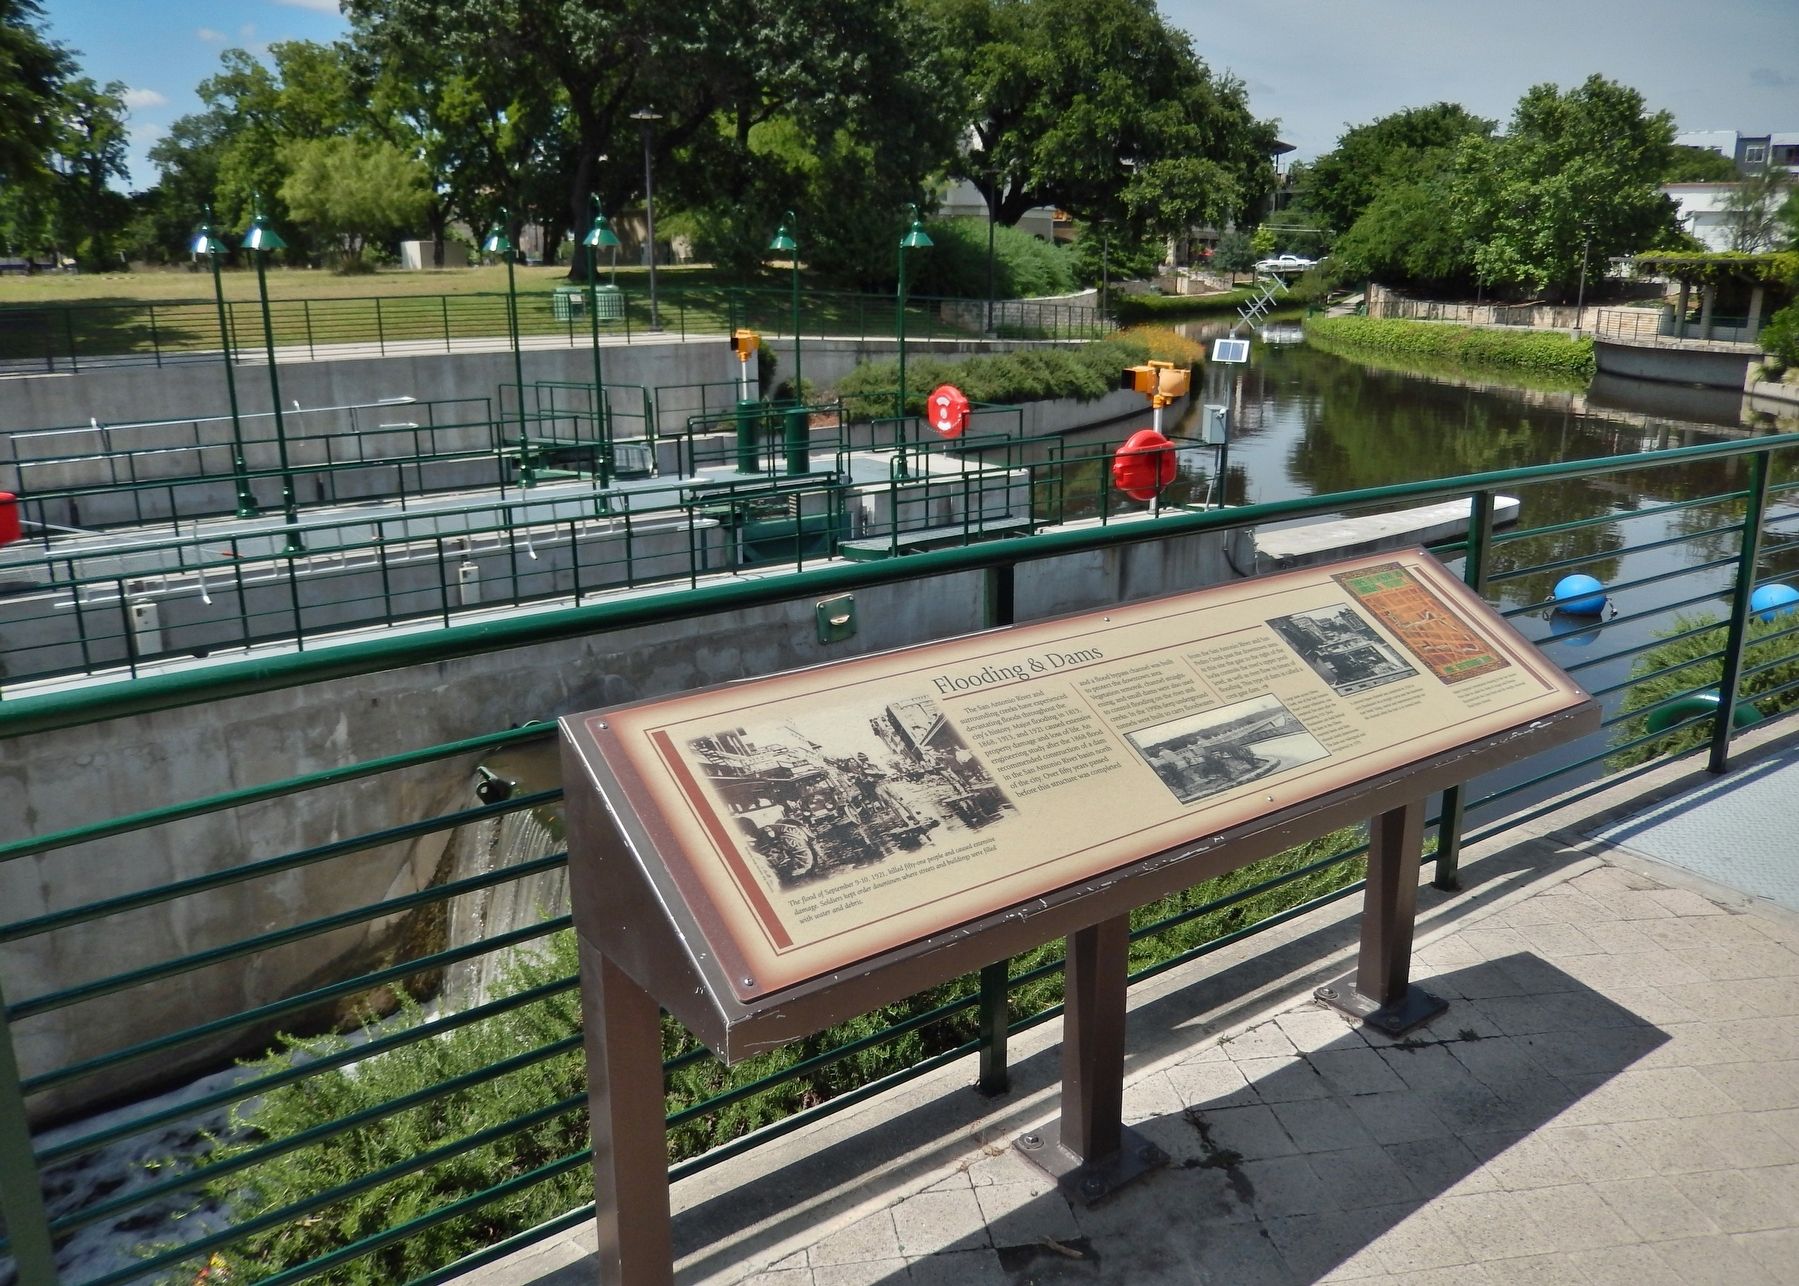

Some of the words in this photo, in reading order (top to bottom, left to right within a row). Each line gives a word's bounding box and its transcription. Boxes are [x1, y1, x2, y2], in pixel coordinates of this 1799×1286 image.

[932, 665, 1030, 694] Flooding
[1030, 656, 1048, 674] &
[1045, 647, 1103, 669] Dams
[1078, 678, 1090, 686] and
[1093, 673, 1110, 681] flood
[1108, 670, 1129, 678] bypass
[1128, 664, 1150, 673] channel
[1158, 658, 1174, 666] built
[1091, 683, 1112, 692] protect
[1121, 673, 1150, 683] downtown
[990, 697, 1015, 706] Antonio
[1031, 689, 1044, 697] and
[1089, 689, 1120, 699] Vegetation
[1143, 677, 1165, 687] channel
[1126, 691, 1142, 699] small
[1175, 691, 1208, 704] underground
[959, 711, 1000, 724] surrounding
[998, 705, 1018, 714] creeks
[1032, 692, 1068, 705] experienced
[1110, 703, 1131, 712] control
[1130, 698, 1156, 707] flooding
[1115, 719, 1137, 729] tunnels
[1149, 712, 1165, 720] built
[1183, 699, 1215, 710] floodwaters
[966, 719, 1002, 731] devastating
[1000, 713, 1021, 723] floods
[1021, 705, 1056, 717] throughout
[972, 731, 988, 739] city's
[1011, 721, 1031, 729] Major
[1030, 714, 1058, 724] flooding
[1015, 729, 1028, 737] and
[1028, 726, 1044, 734] 1921
[1044, 720, 1065, 730] caused
[1065, 714, 1091, 724] extensive
[984, 745, 1011, 757] property
[1012, 738, 1036, 748] damage
[1037, 733, 1049, 741] and
[990, 750, 1029, 764] engineering
[1027, 745, 1045, 753] study
[1085, 728, 1103, 737] flood
[997, 754, 1042, 772] recommended
[1042, 745, 1080, 759] construction
[1035, 760, 1061, 771] Antonio
[1076, 751, 1095, 759] basin
[1094, 745, 1112, 754] north
[1042, 771, 1059, 779] Over
[1058, 766, 1072, 774] fifty
[1071, 762, 1088, 772] years
[1088, 755, 1109, 767] passed
[1014, 787, 1037, 797] before
[1036, 783, 1050, 791] this
[1050, 775, 1078, 787] structure
[1090, 761, 1122, 775] completed
[801, 892, 816, 903] flood
[823, 882, 853, 895] September
[887, 864, 904, 874] killed
[926, 852, 943, 863] people
[944, 848, 955, 856] and
[955, 843, 972, 853] caused
[973, 837, 995, 847] extensive
[819, 896, 843, 906] Soldiers
[856, 886, 871, 894] order
[872, 877, 901, 889] downtown
[901, 871, 917, 879] where
[918, 865, 935, 874] streets
[935, 860, 946, 868] and
[945, 854, 970, 865] buildings
[982, 844, 997, 854] filled
[799, 914, 813, 923] with
[814, 909, 830, 919] water
[831, 904, 844, 913] and
